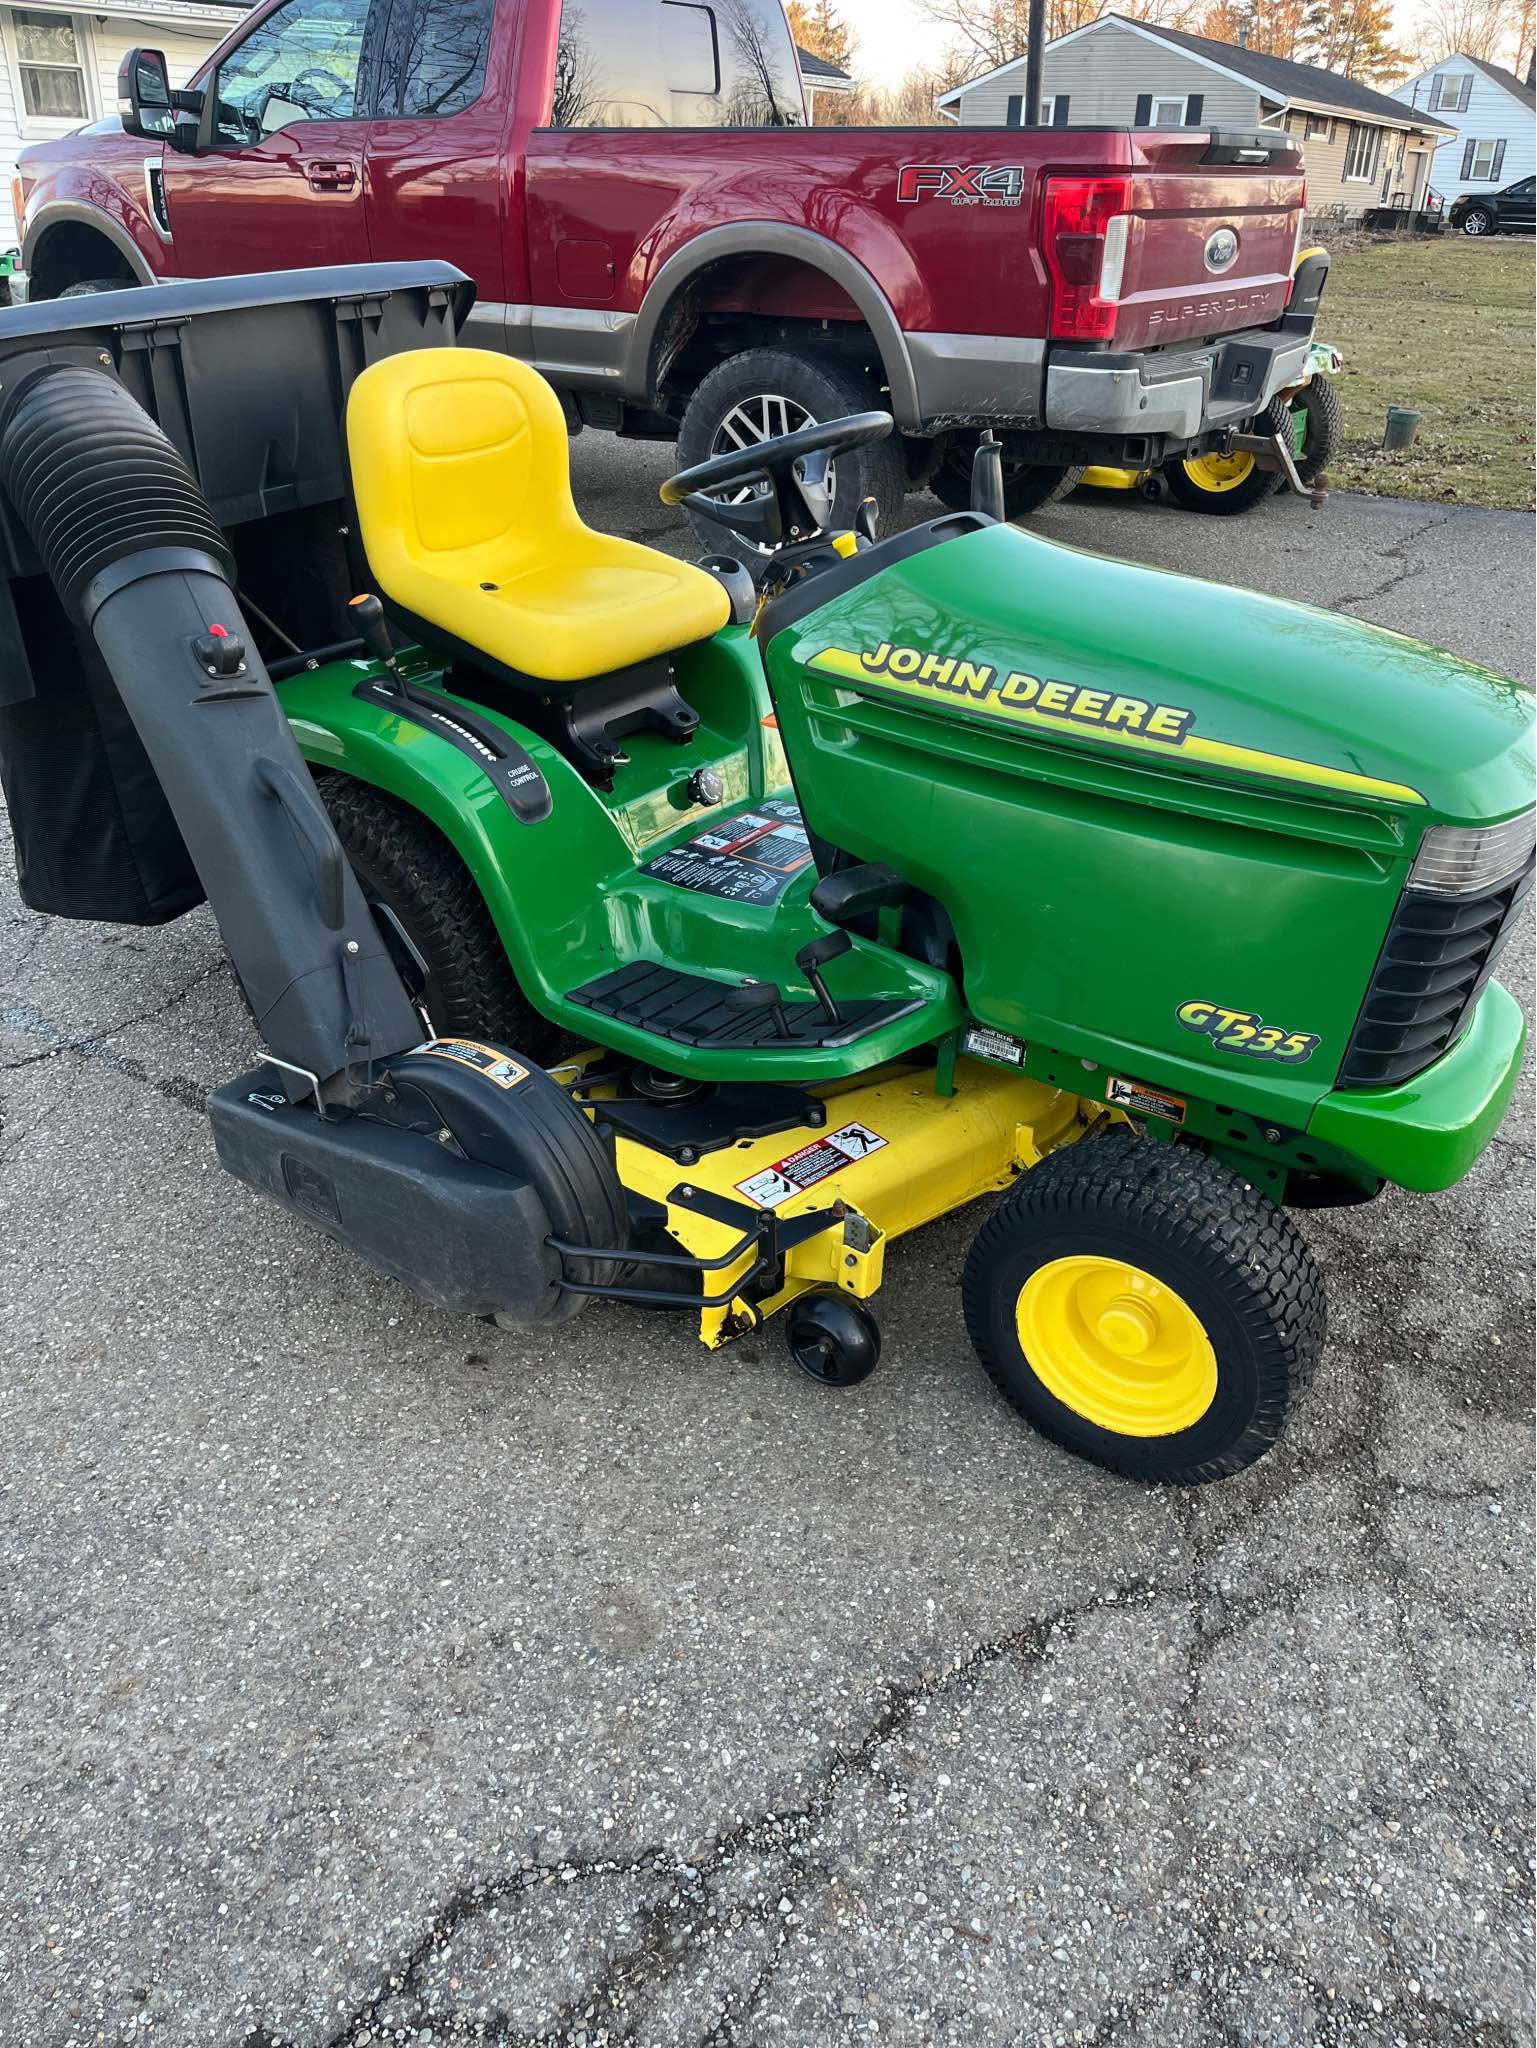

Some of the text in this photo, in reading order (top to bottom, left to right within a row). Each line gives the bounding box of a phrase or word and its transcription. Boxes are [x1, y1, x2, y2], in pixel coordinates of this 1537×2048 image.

[897, 165, 1024, 202] FX4
[951, 197, 1021, 207] OFF ROAD
[1148, 293, 1271, 325] SUPER DUTY
[861, 642, 1195, 743] JOHN DEERE
[507, 764, 530, 778] CRUISE
[510, 771, 540, 787] CONTROL
[788, 1143, 822, 1163] DANGER
